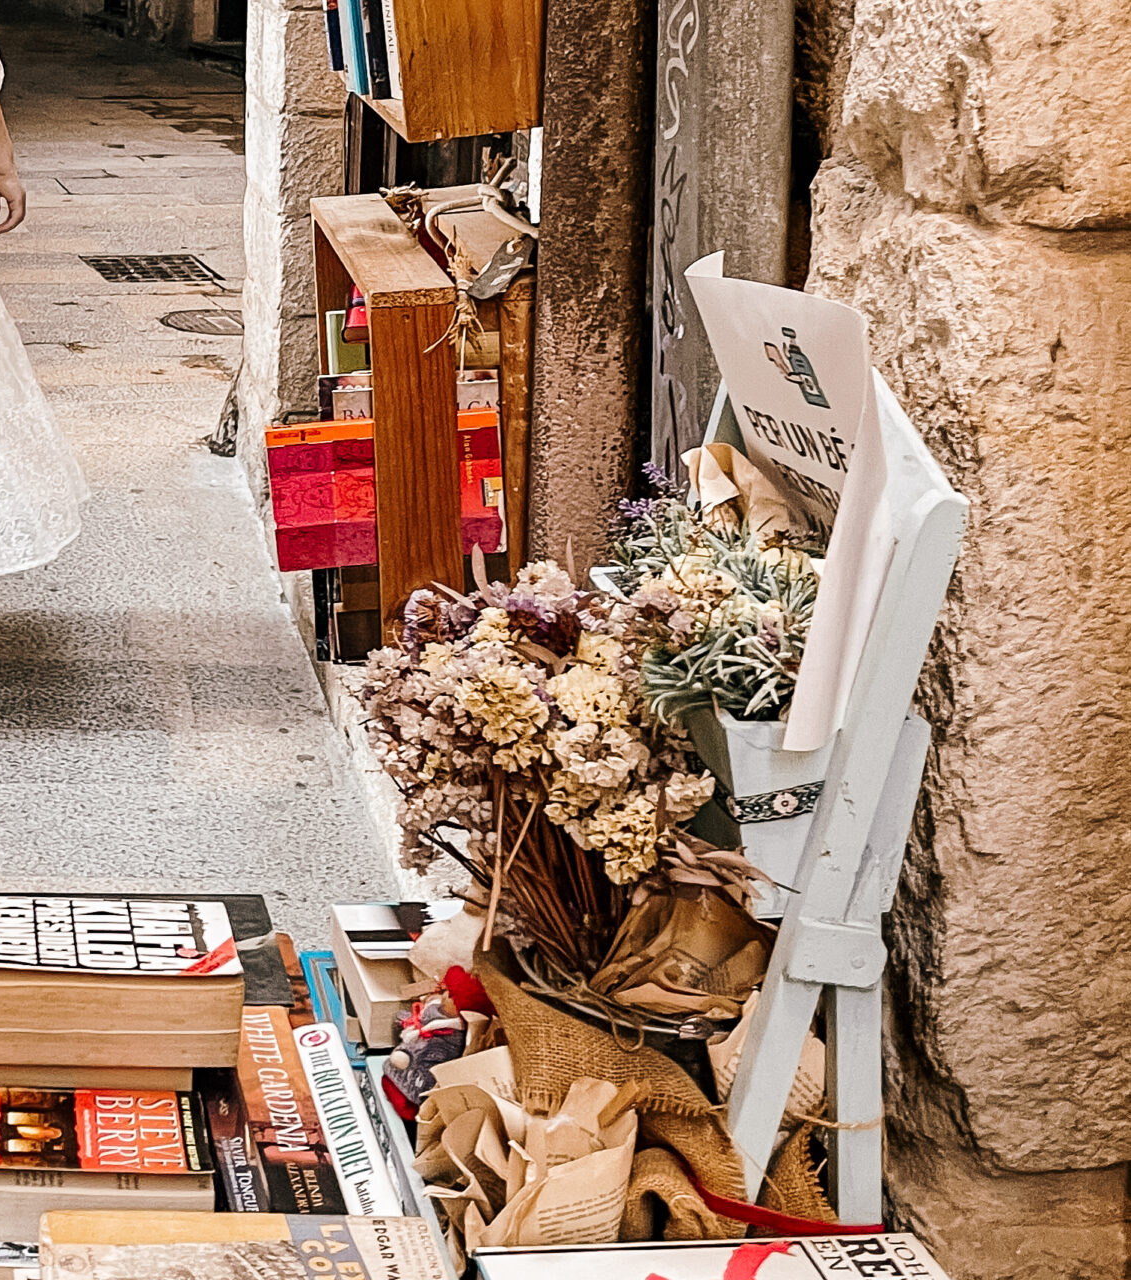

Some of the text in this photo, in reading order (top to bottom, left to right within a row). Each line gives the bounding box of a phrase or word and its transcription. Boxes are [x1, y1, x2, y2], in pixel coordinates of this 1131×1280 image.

[742, 404, 788, 449] PER
[781, 420, 822, 463] UN
[36, 899, 77, 966] PRESIDENT
[72, 901, 137, 969] KILLED
[130, 900, 199, 970] MAFIA
[243, 1012, 310, 1152] WHITE GARDENIA
[309, 1048, 332, 1070] THE
[95, 1094, 141, 1169] BERRY
[137, 1097, 184, 1168] STEVE
[312, 1068, 358, 1141] ROTATION
[335, 1136, 375, 1180] DIET
[319, 1224, 350, 1254] LA
[372, 1219, 395, 1259] EDGAR
[885, 1237, 930, 1280] JOH
